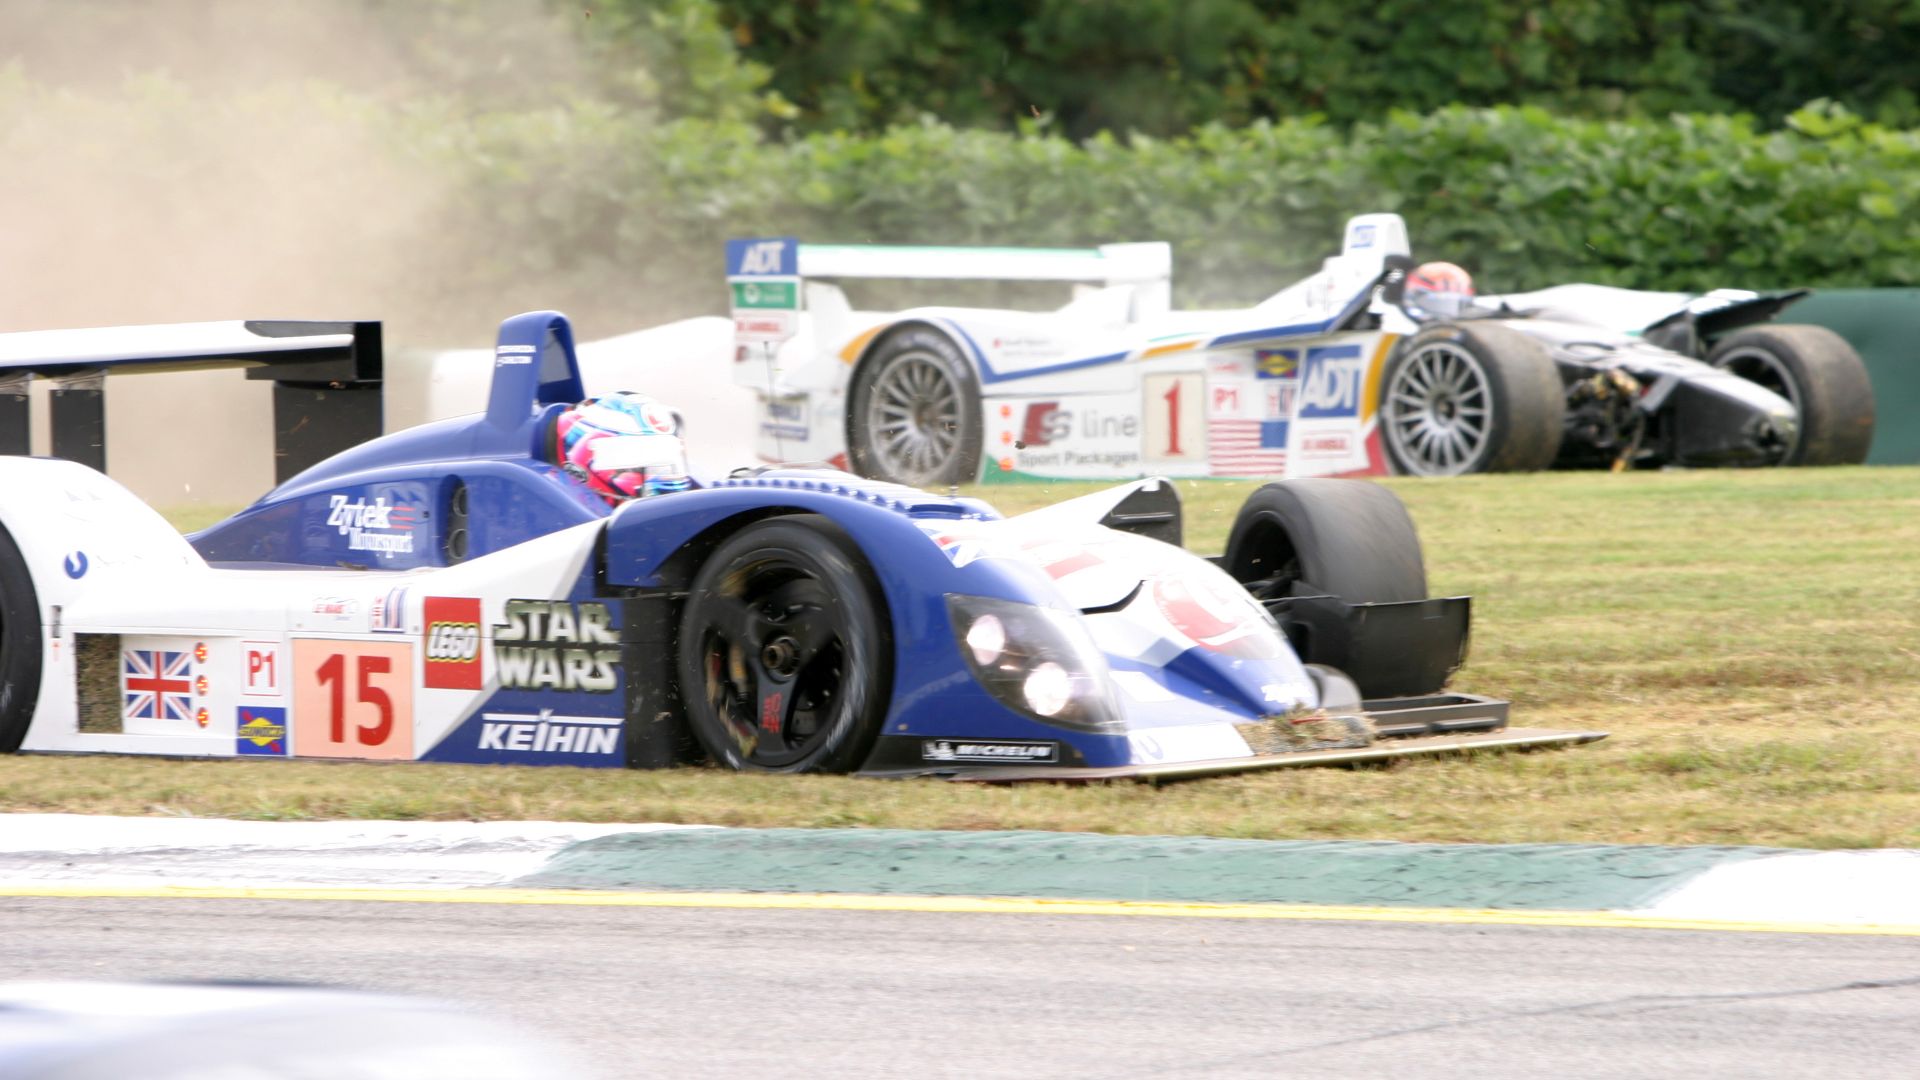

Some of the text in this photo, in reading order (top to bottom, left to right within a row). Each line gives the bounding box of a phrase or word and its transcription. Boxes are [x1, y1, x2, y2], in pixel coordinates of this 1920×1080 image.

[740, 241, 786, 273] ADT
[1213, 389, 1240, 410] P1
[1300, 357, 1360, 410] ADT
[1039, 410, 1138, 441] S line
[1163, 378, 1184, 455] 1
[326, 495, 394, 535] Zytek
[425, 621, 481, 663] LEGO
[492, 599, 622, 645] STAR
[247, 650, 276, 688] P1
[495, 645, 622, 693] WARS
[315, 653, 395, 746] 15
[478, 720, 621, 754] KEIHIN
[956, 745, 1051, 757] MICHELIN
